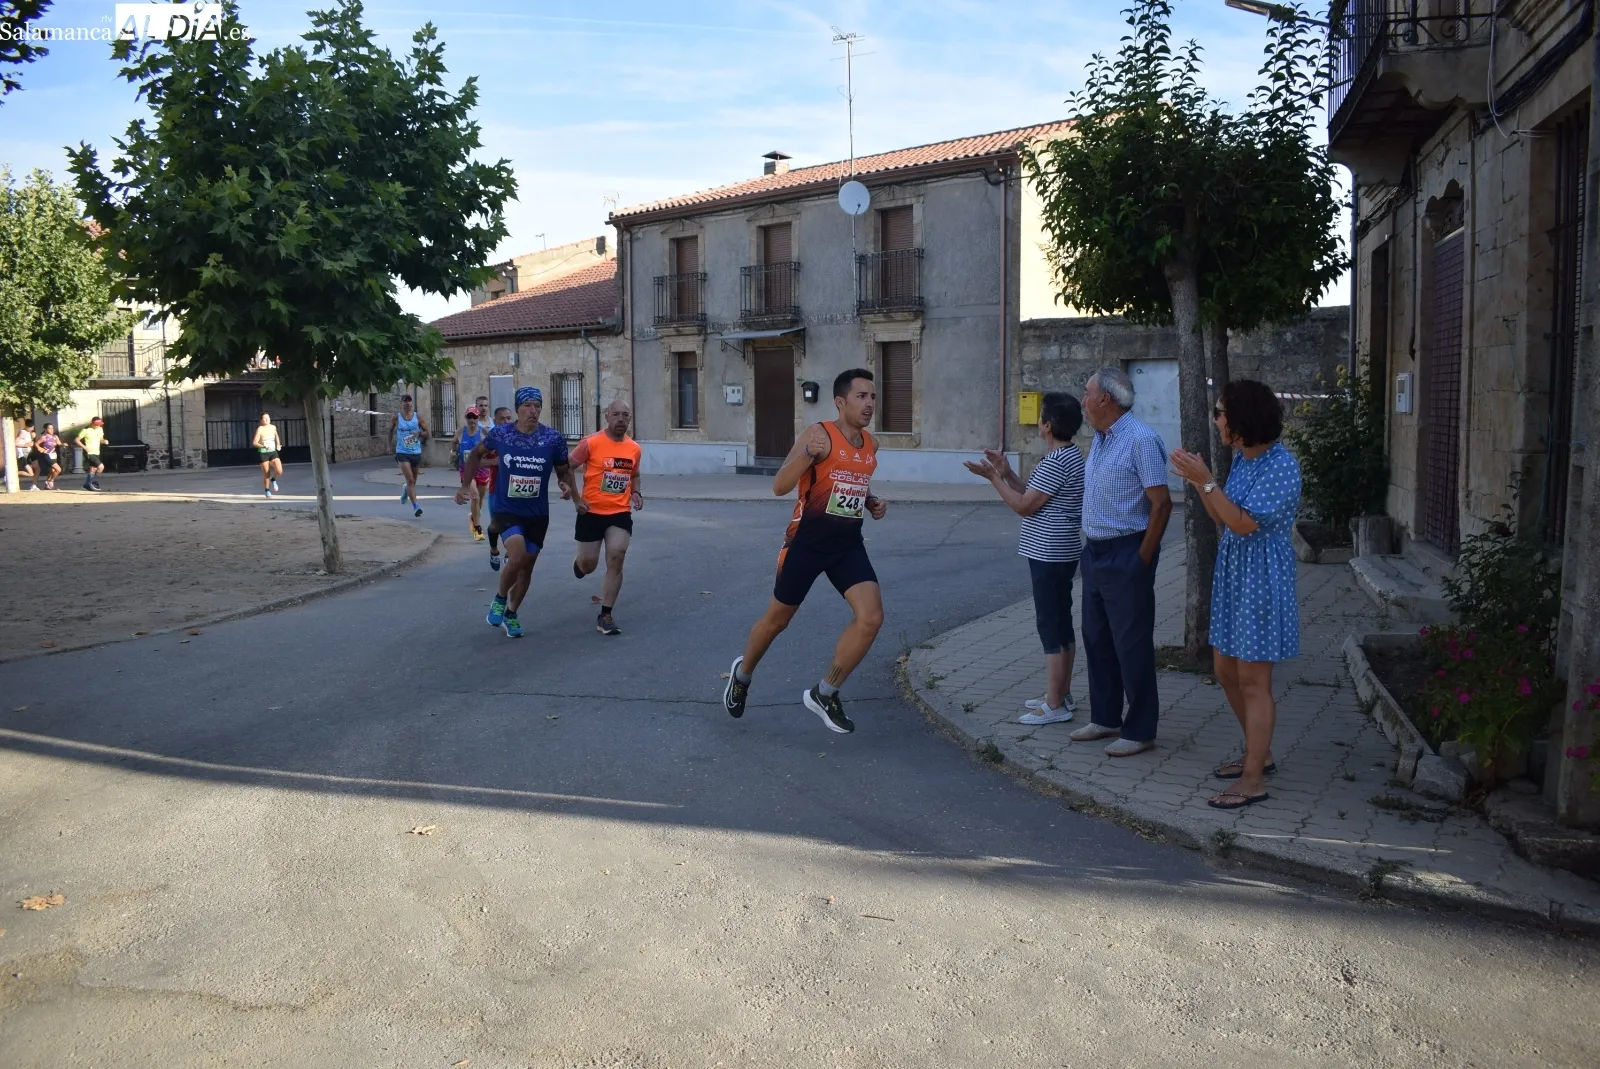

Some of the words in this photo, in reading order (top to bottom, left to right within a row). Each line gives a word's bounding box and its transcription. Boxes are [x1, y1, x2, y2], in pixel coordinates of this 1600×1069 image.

[515, 484, 534, 493] 240
[607, 481, 625, 490] 205
[837, 496, 860, 510] 248
